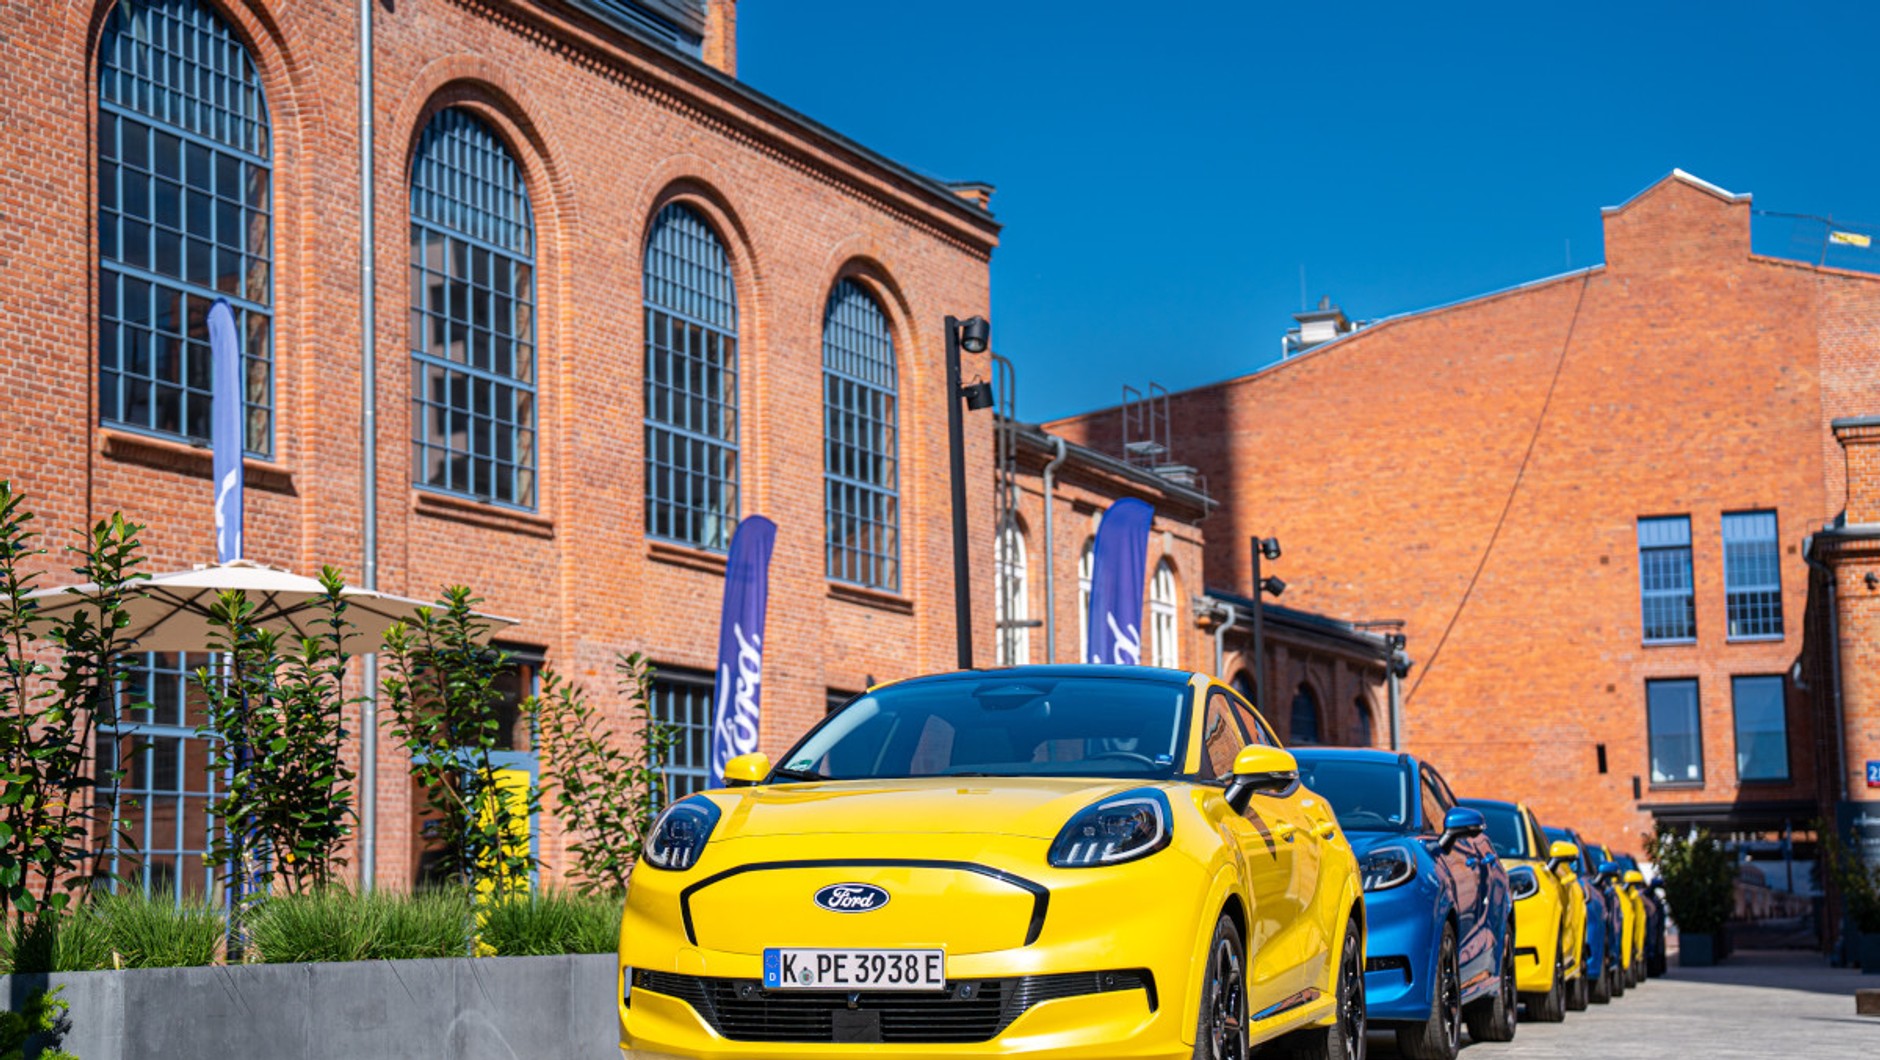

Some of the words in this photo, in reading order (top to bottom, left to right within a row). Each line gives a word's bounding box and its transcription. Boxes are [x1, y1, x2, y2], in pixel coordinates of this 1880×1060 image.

[713, 622, 760, 782] Ford
[828, 887, 875, 908] Ford
[769, 972, 777, 982] D
[783, 954, 797, 983] K
[817, 954, 848, 983] PE
